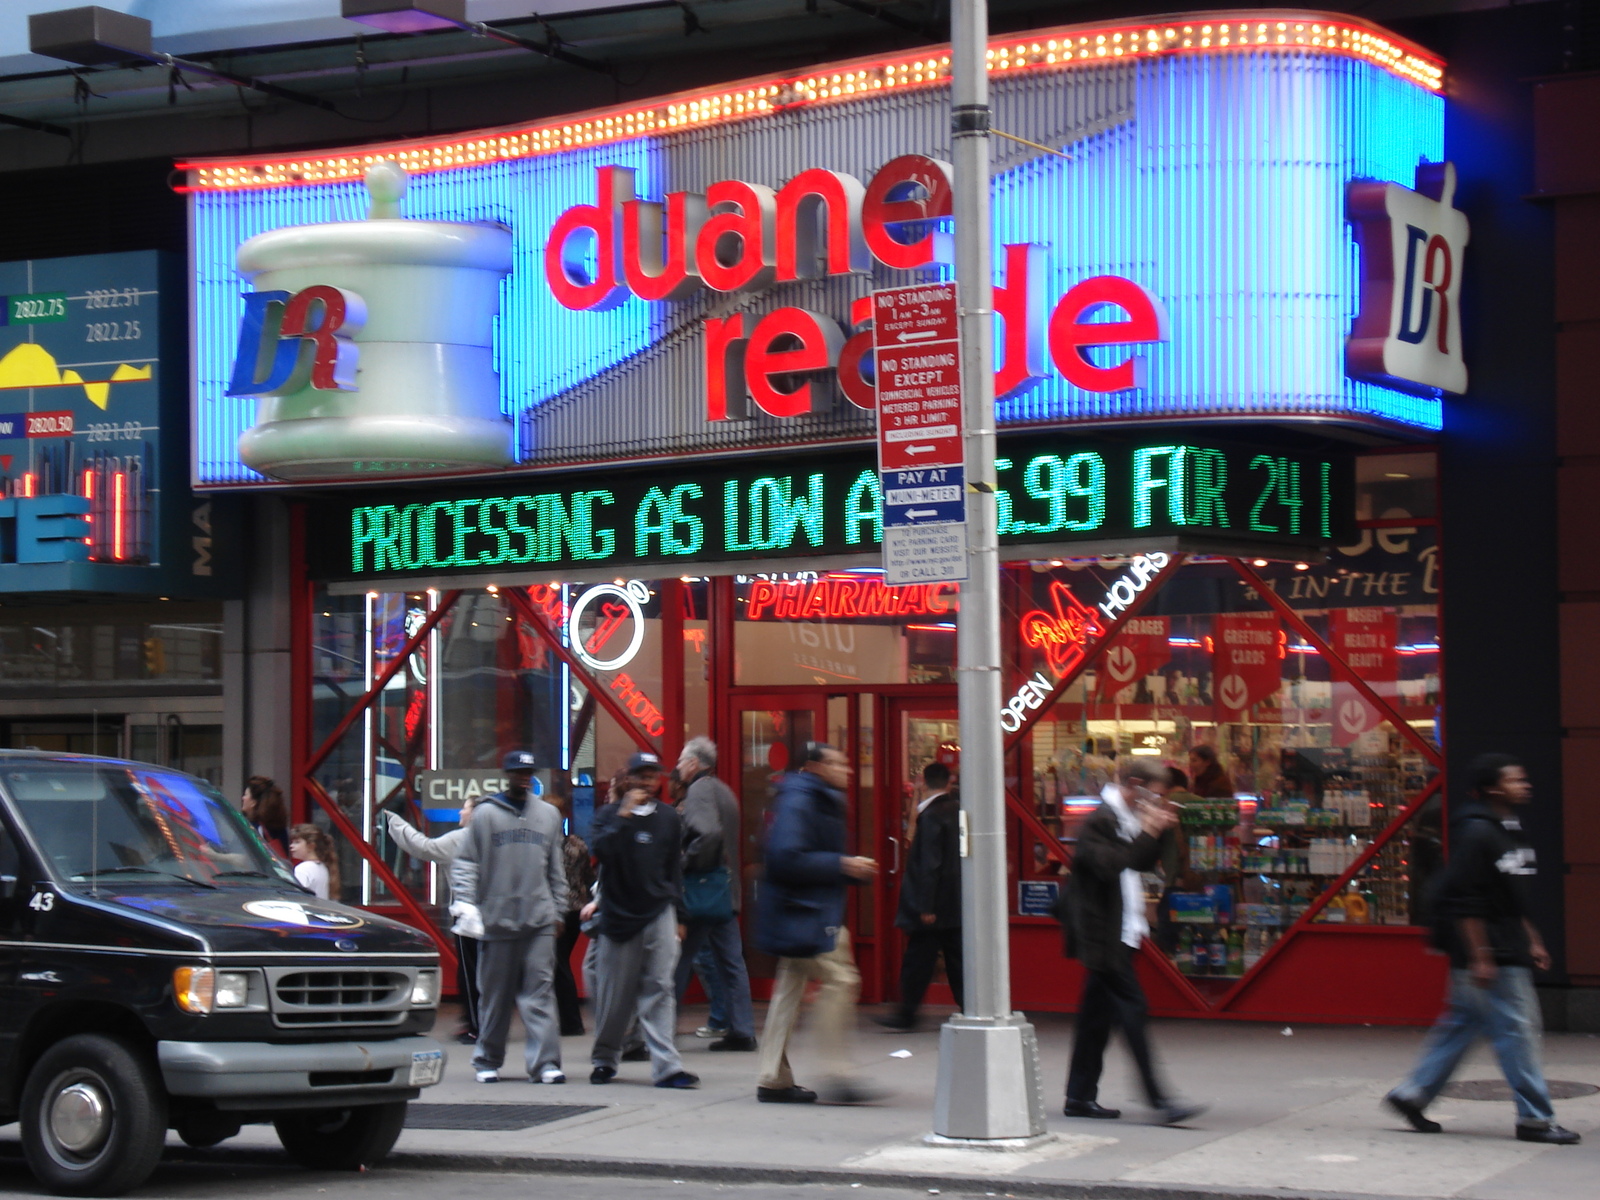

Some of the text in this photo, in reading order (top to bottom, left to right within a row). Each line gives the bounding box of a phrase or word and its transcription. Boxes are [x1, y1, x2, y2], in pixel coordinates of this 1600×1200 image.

[545, 154, 953, 311] duane
[878, 288, 953, 308] NO STANDING
[1398, 223, 1452, 356] DR
[14, 299, 65, 318] 2822.75
[85, 320, 142, 342] 2822.25
[884, 317, 948, 331] EXCEPT SUNDAY
[225, 284, 350, 397] DR
[881, 353, 955, 372] NO STANDING
[894, 370, 943, 387] EXCEPT
[880, 385, 960, 401] COMMERCIAL VEHICLES
[882, 398, 959, 414] METERED PARKING
[893, 411, 950, 427] 3 HR LIMIT
[897, 469, 947, 485] PAY AT
[890, 487, 958, 504] MUNI-METER
[351, 489, 616, 573] PROCESSING
[634, 483, 704, 557] AS
[724, 473, 824, 552] LOW
[1133, 445, 1231, 528] FOR
[1249, 454, 1304, 535] 24
[911, 567, 938, 578] CALL
[1288, 575, 1331, 598] IN
[1340, 572, 1412, 597] THE
[748, 578, 960, 621] PHARMAC
[1000, 672, 1054, 732] OPEN
[1098, 551, 1169, 620] HOURS
[1223, 628, 1273, 645] GREETING
[1231, 649, 1266, 665] CARDS
[610, 673, 665, 737] PHOTO
[29, 892, 55, 912] 43
